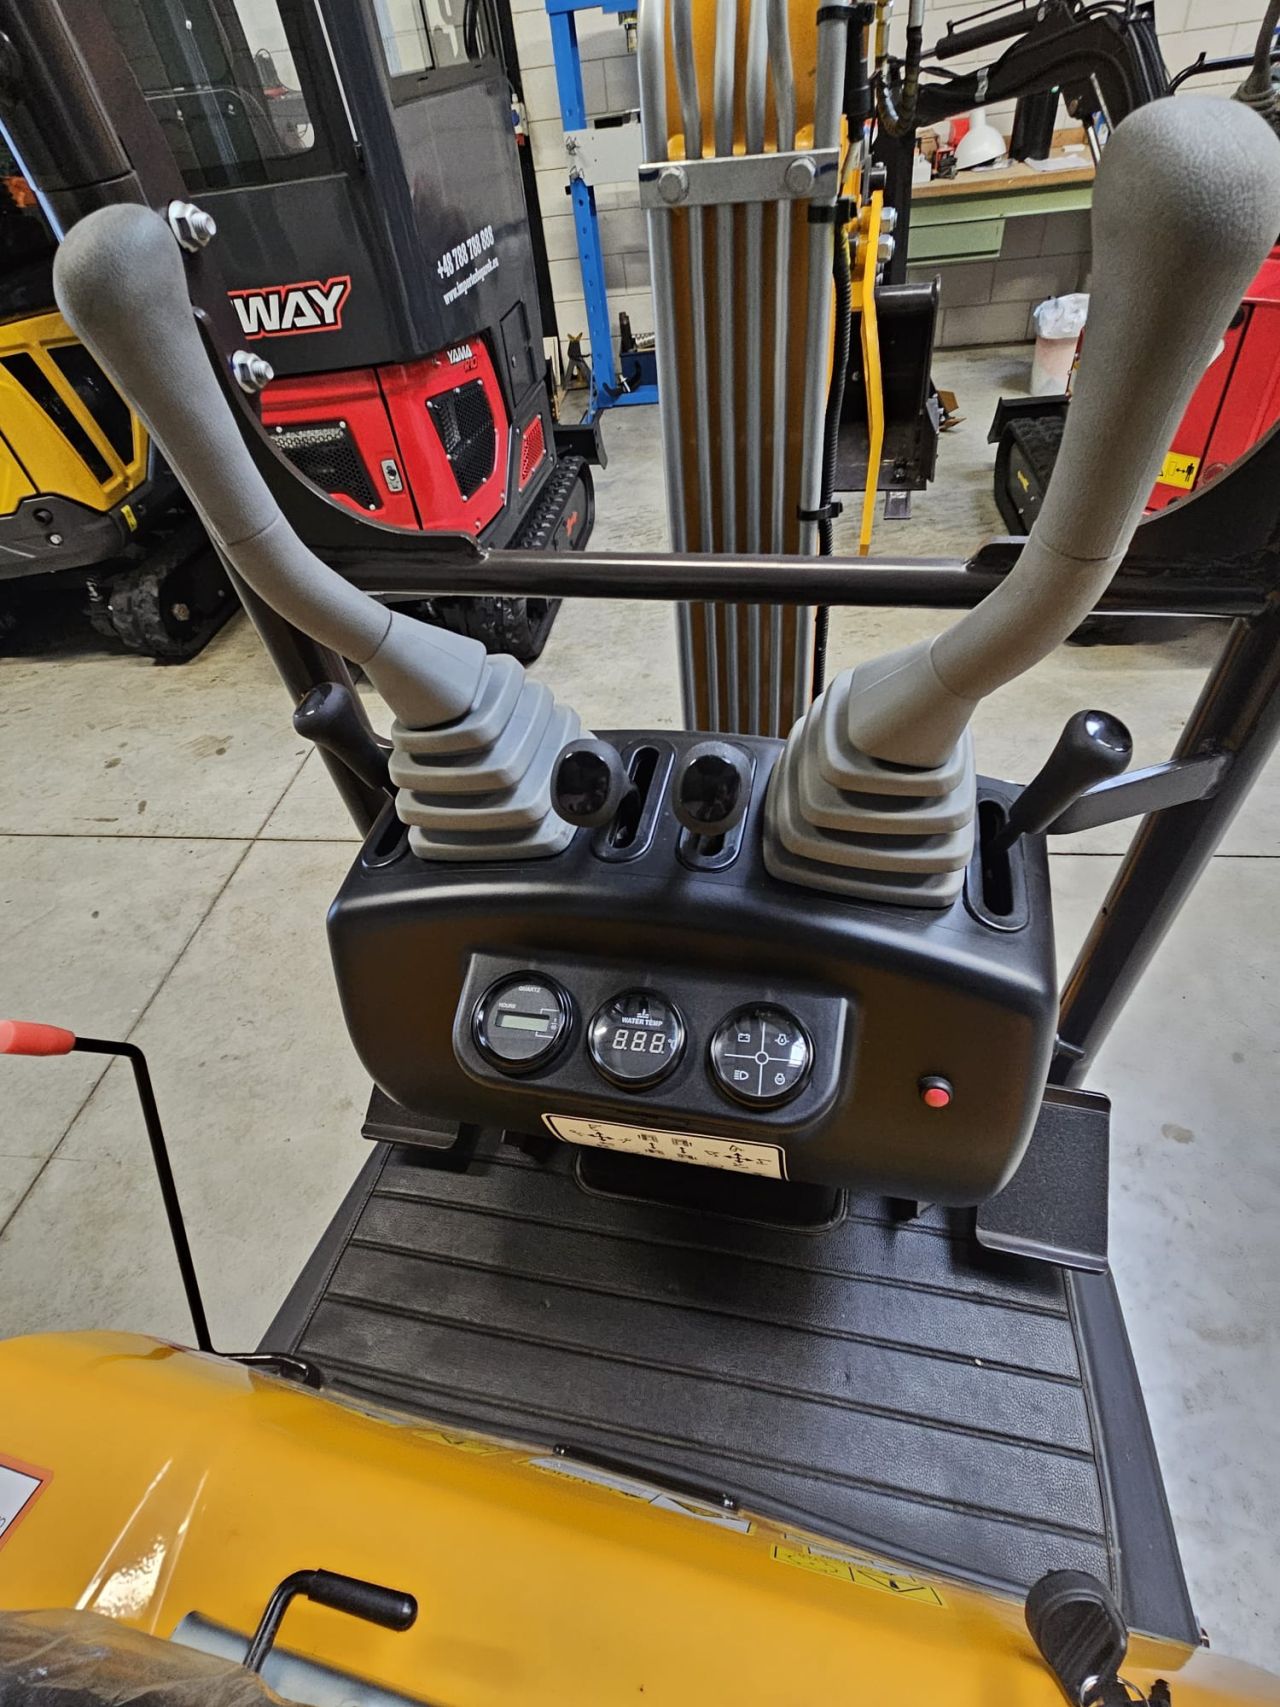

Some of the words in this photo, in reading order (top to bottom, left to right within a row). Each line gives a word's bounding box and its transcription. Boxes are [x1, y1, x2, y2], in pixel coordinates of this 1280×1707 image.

[451, 242, 469, 271] 788
[466, 233, 482, 261] 788
[230, 284, 344, 334] WAY
[447, 344, 473, 364] YAMA
[621, 1016, 644, 1025] WATER
[645, 1019, 663, 1027] TEMP
